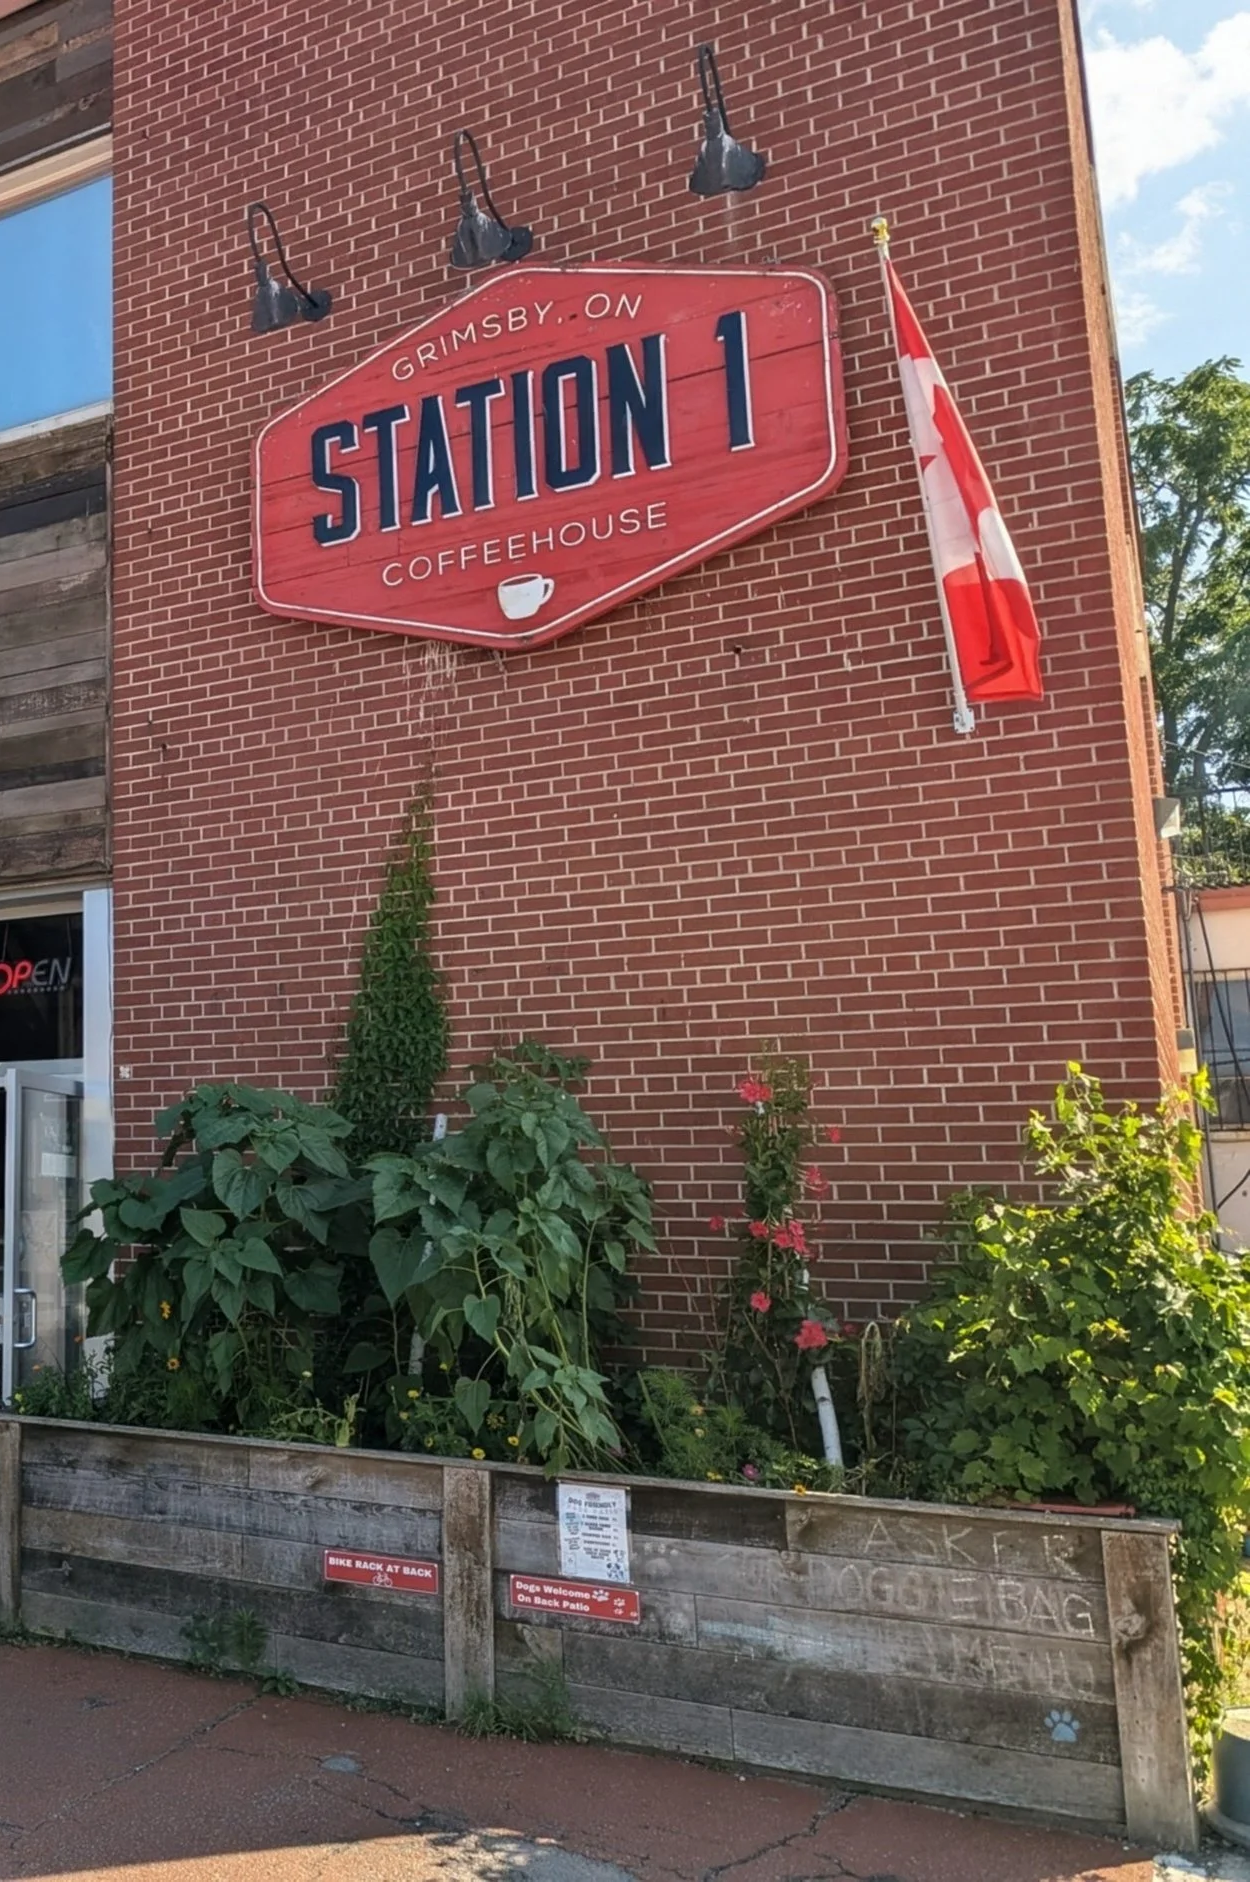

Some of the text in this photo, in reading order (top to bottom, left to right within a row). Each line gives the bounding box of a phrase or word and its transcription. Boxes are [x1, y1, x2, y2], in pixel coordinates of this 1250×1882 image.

[392, 293, 642, 382] GRIMSBY, ON
[311, 310, 755, 547] STATION 1
[381, 501, 668, 587] COFFEEHOUSE
[328, 1557, 432, 1578] BIKE RACK AT BACK
[516, 1581, 590, 1599] Dogs Welcome
[517, 1594, 590, 1612] On Back Patio
[996, 1579, 1096, 1638] BAG
